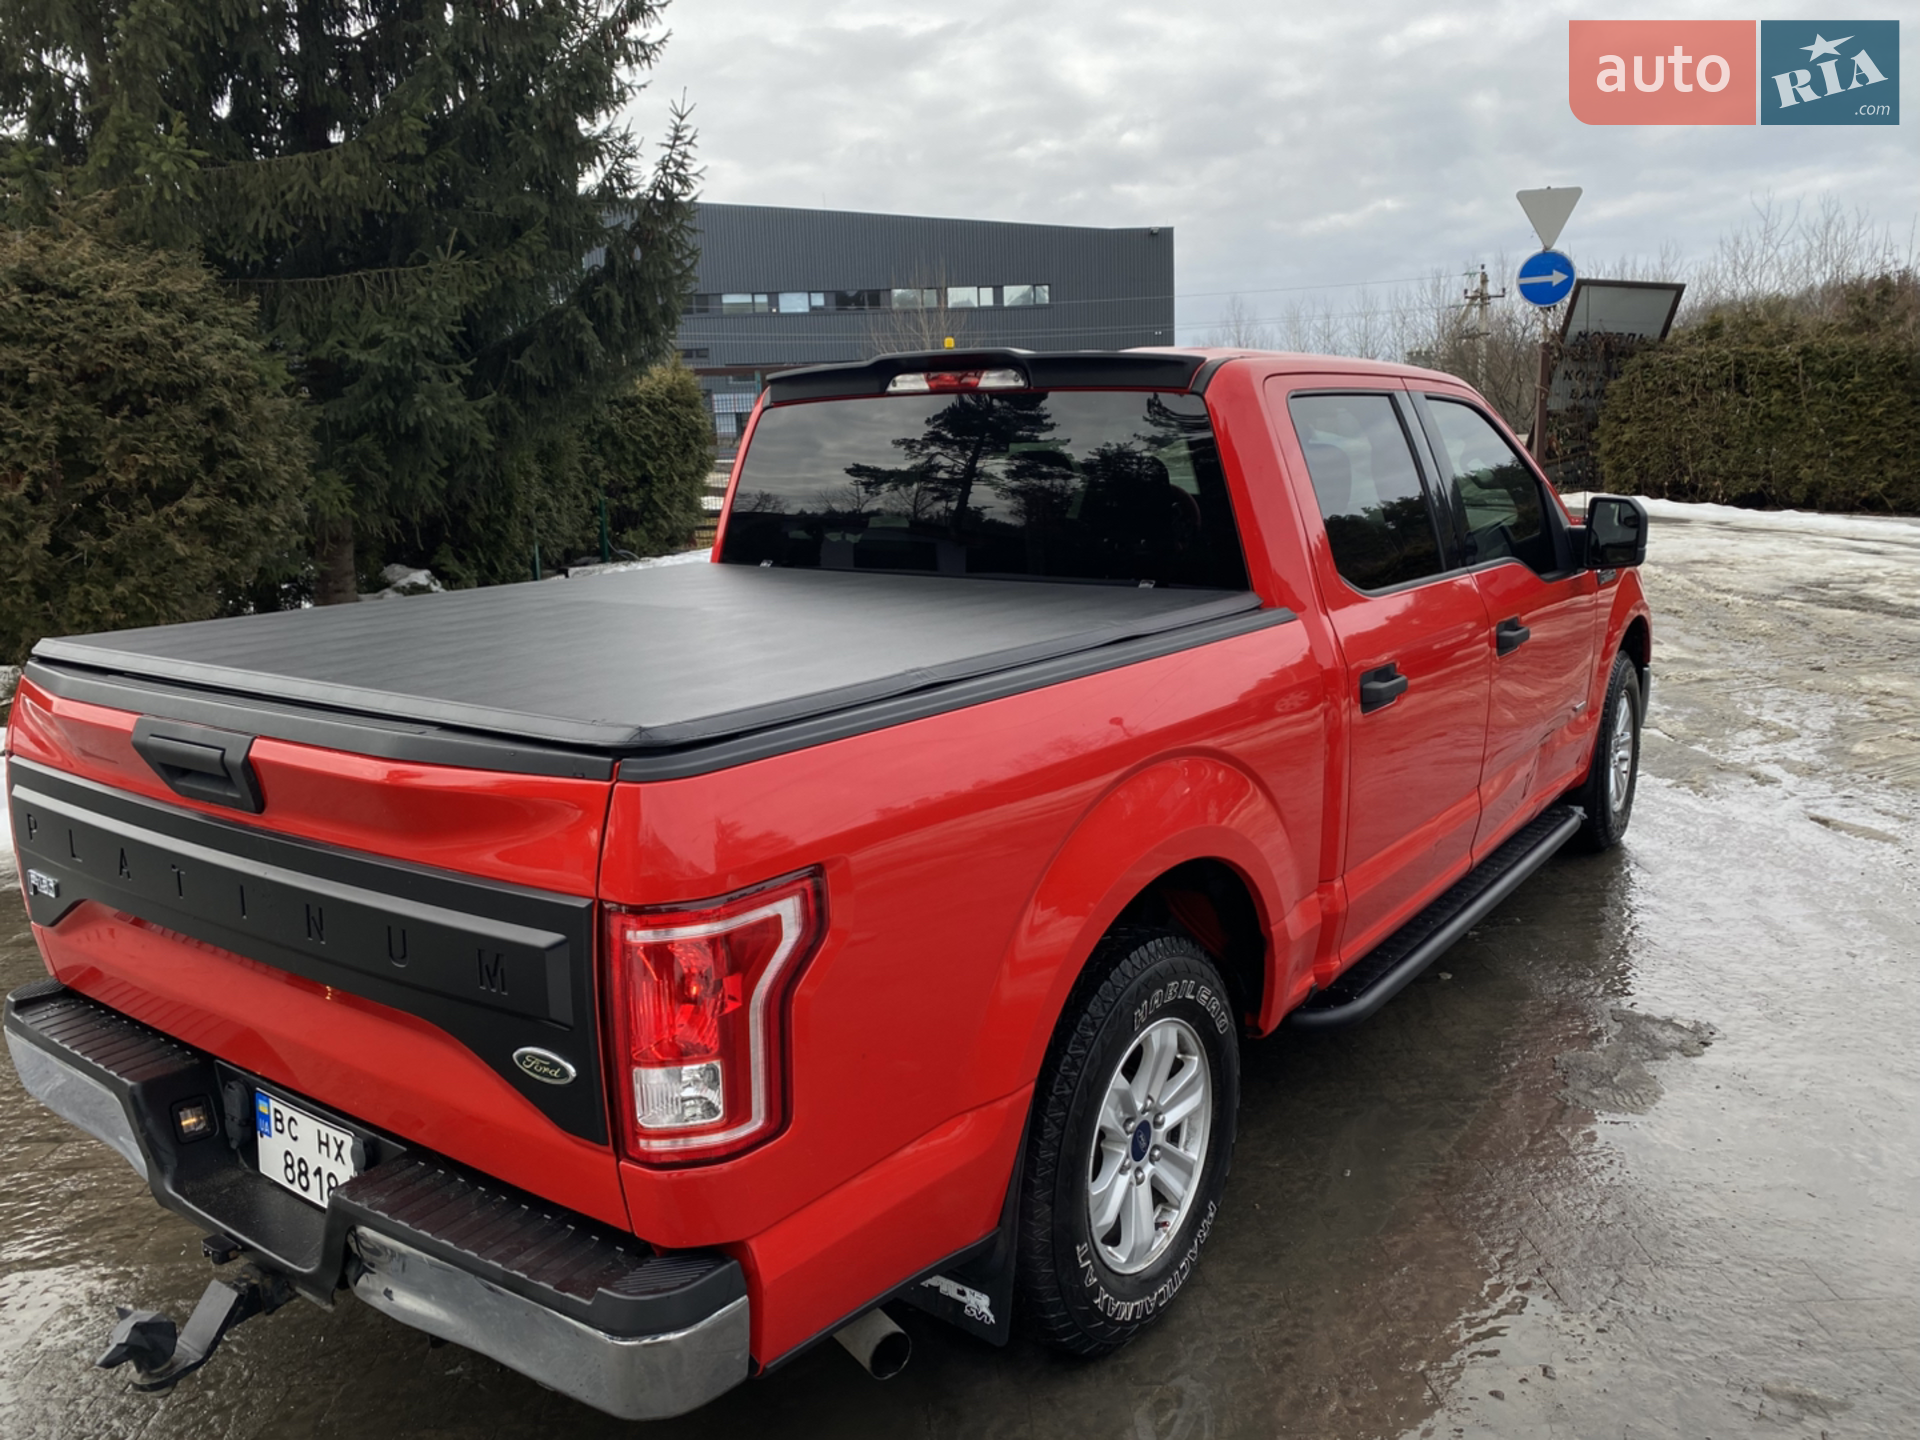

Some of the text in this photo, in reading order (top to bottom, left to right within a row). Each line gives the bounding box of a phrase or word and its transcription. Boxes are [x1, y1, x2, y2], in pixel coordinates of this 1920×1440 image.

[26, 813, 508, 995] PLATINUM
[1134, 979, 1229, 1035] HABILEAD
[522, 1054, 561, 1078] Ford
[273, 1107, 346, 1166] BC HX
[283, 1149, 339, 1201] 8818
[1093, 1200, 1218, 1321] PRACTICALMAX
